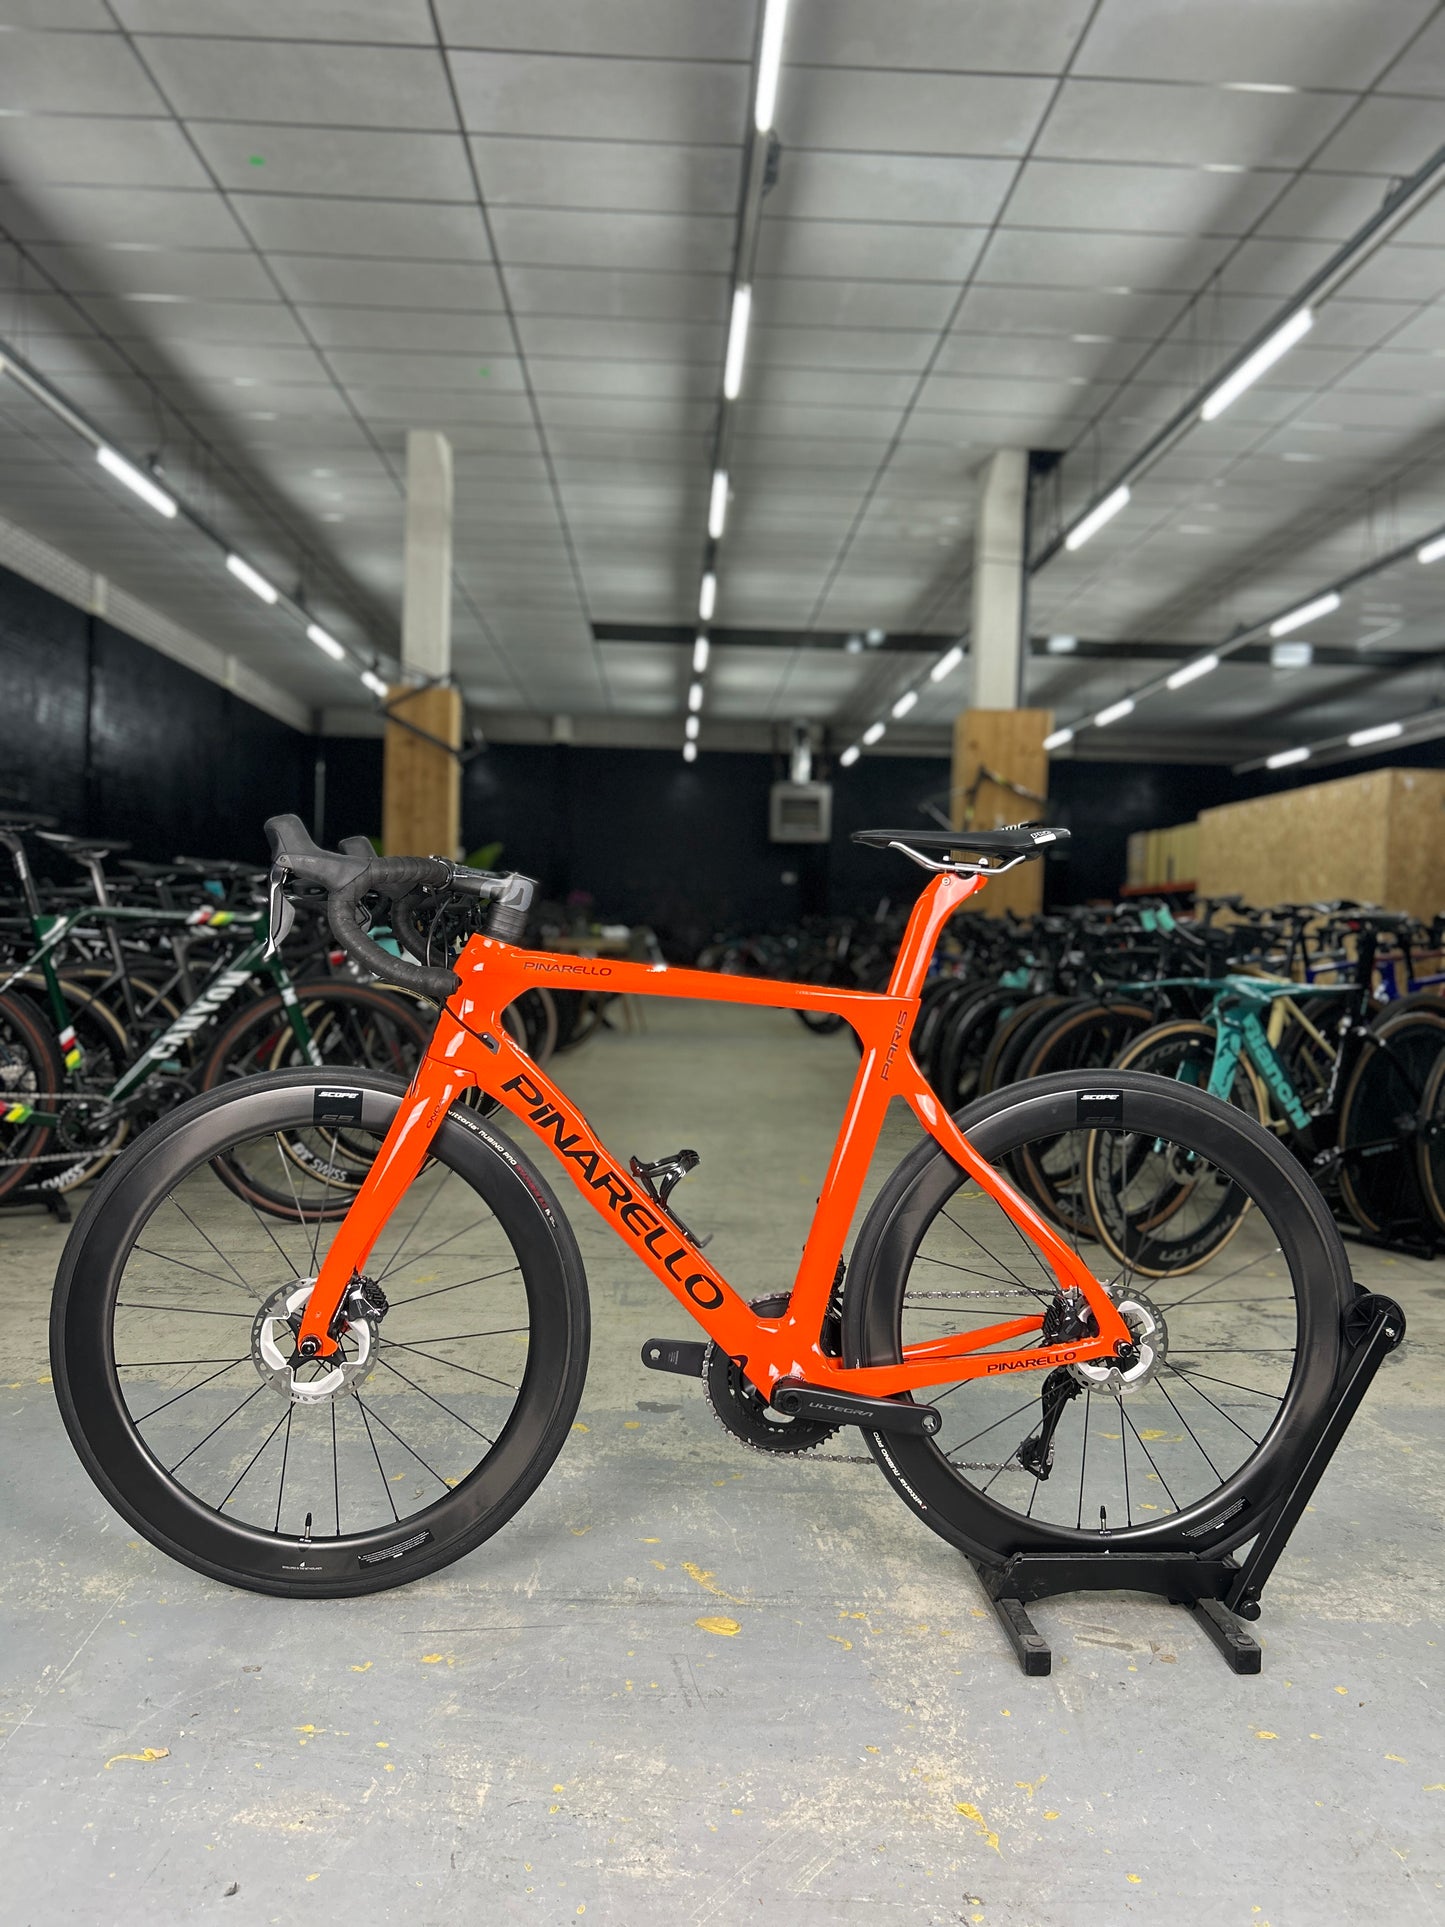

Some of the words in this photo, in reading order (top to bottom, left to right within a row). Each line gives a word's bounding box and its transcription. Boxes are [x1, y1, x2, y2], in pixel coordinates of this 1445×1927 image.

[523, 962, 613, 976] PINARELLO
[148, 970, 252, 1060] CANYON
[880, 1010, 908, 1081] PARIS
[1242, 1013, 1312, 1130] Bianchi
[318, 1091, 360, 1099] SCOPE
[309, 1158, 348, 1182] SWISS
[987, 1351, 1078, 1374] PINARELLO
[808, 1402, 875, 1418] ULTEGRA
